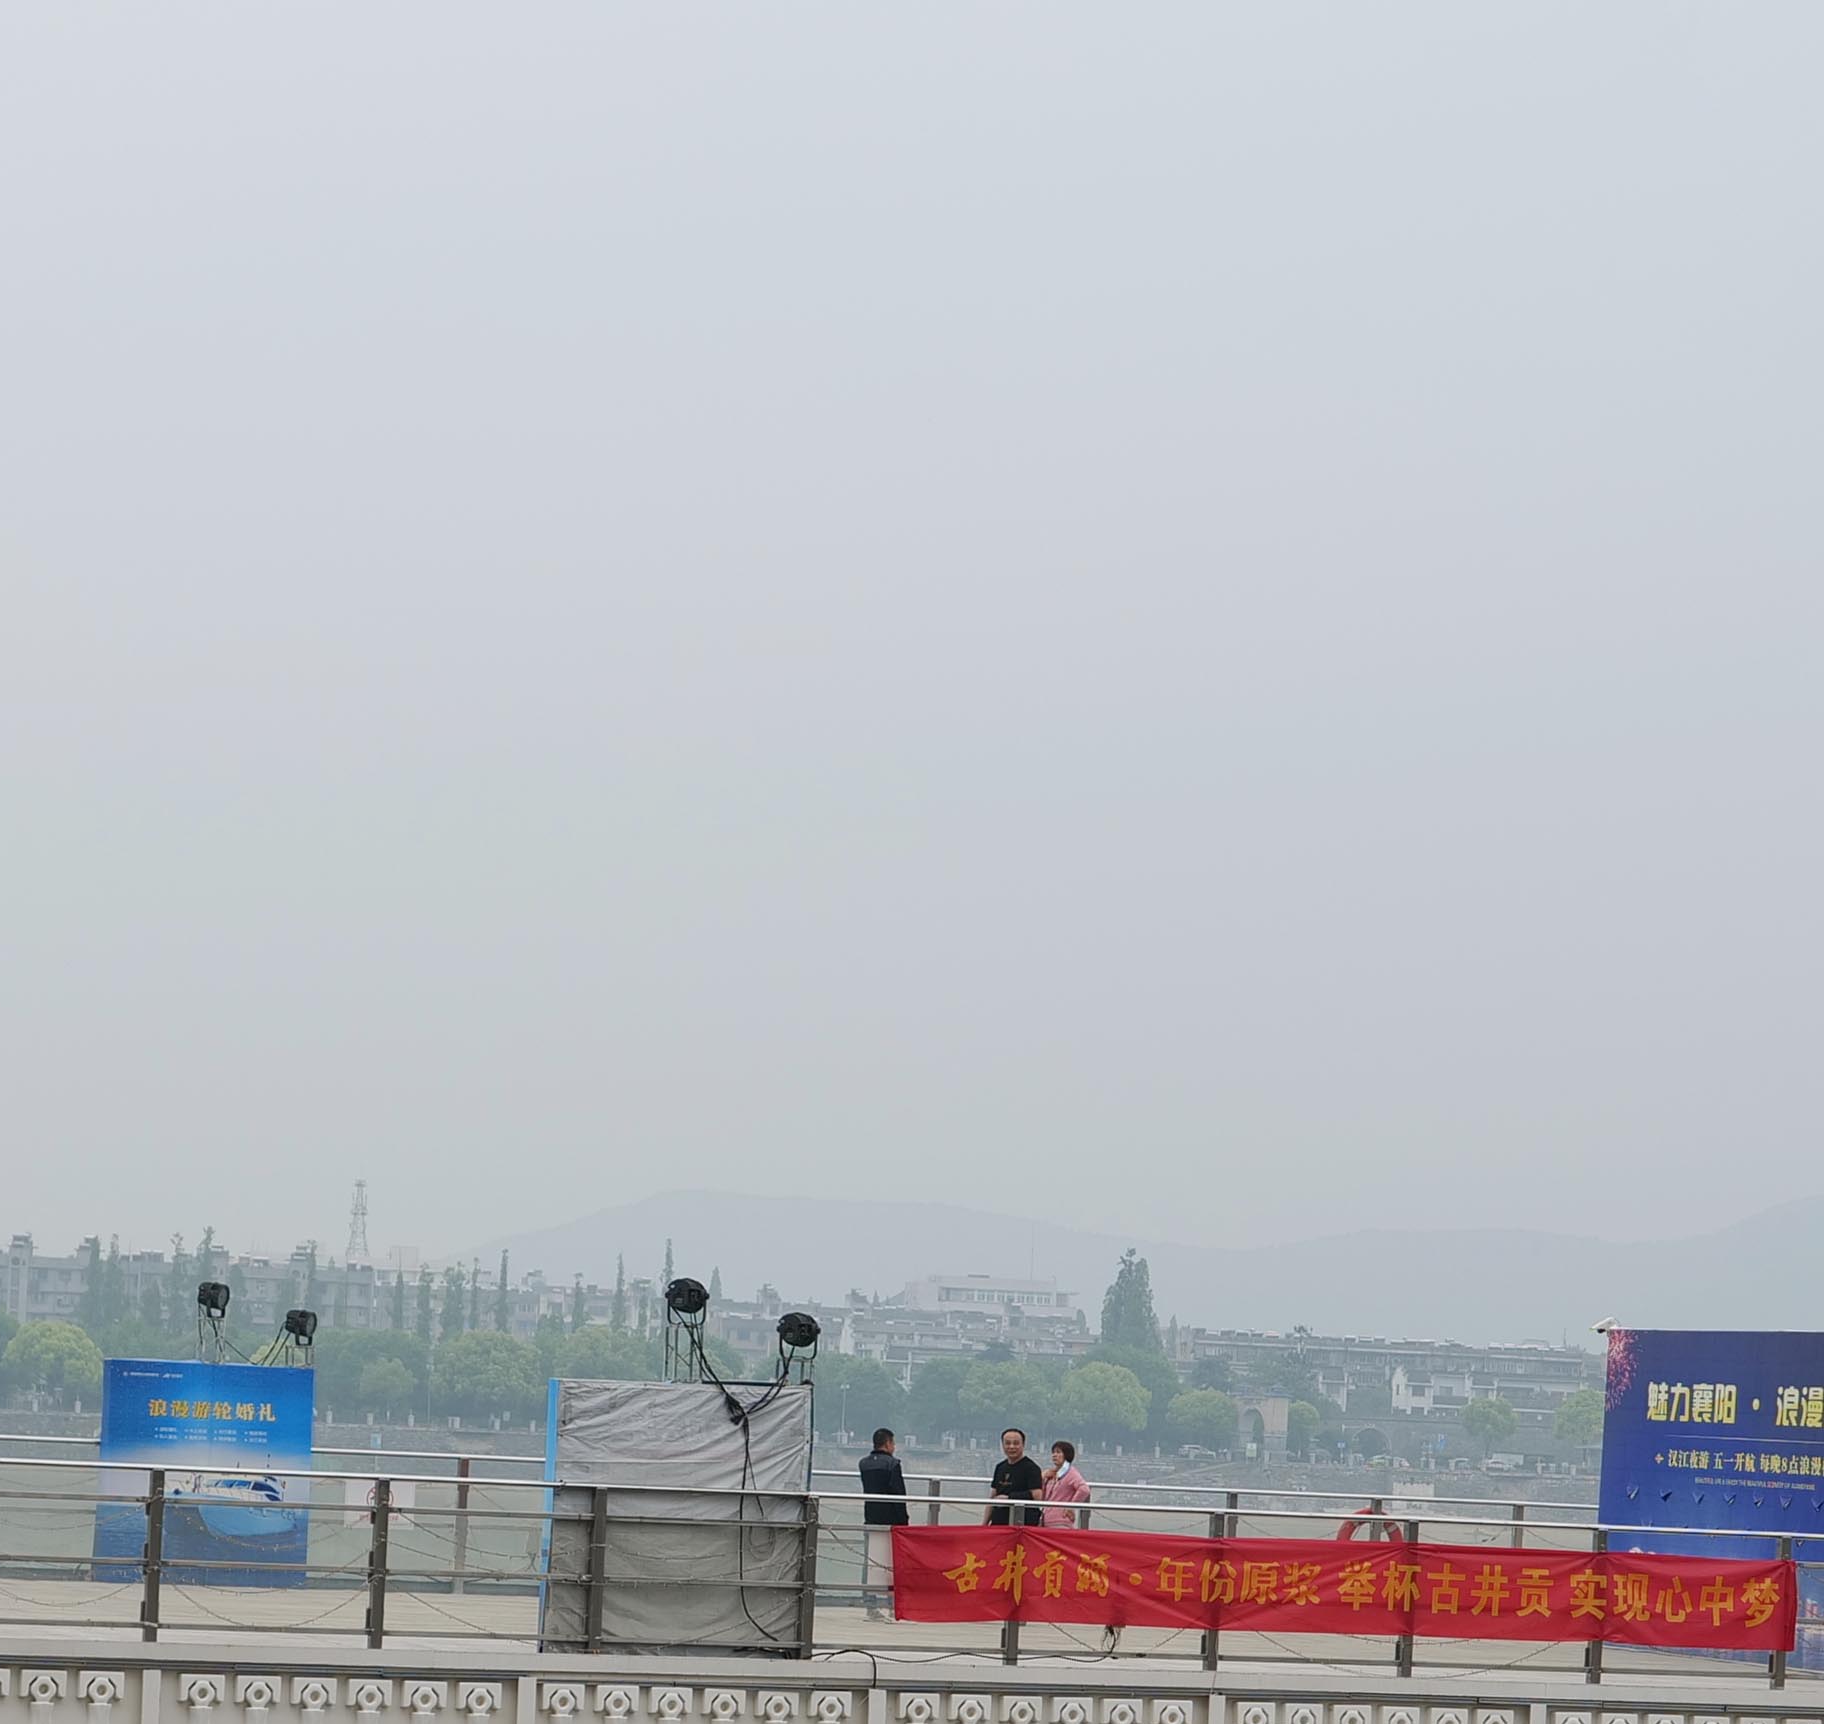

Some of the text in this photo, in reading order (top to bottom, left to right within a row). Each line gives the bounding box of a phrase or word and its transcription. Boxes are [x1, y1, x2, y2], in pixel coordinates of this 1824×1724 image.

[148, 1399, 277, 1422] 浪漫游轮婚礼
[1667, 1449, 1710, 1470] 汉江夜游
[1336, 1557, 1554, 1619] 举杯古井贡
[1567, 1568, 1783, 1630] 实现心中梦
